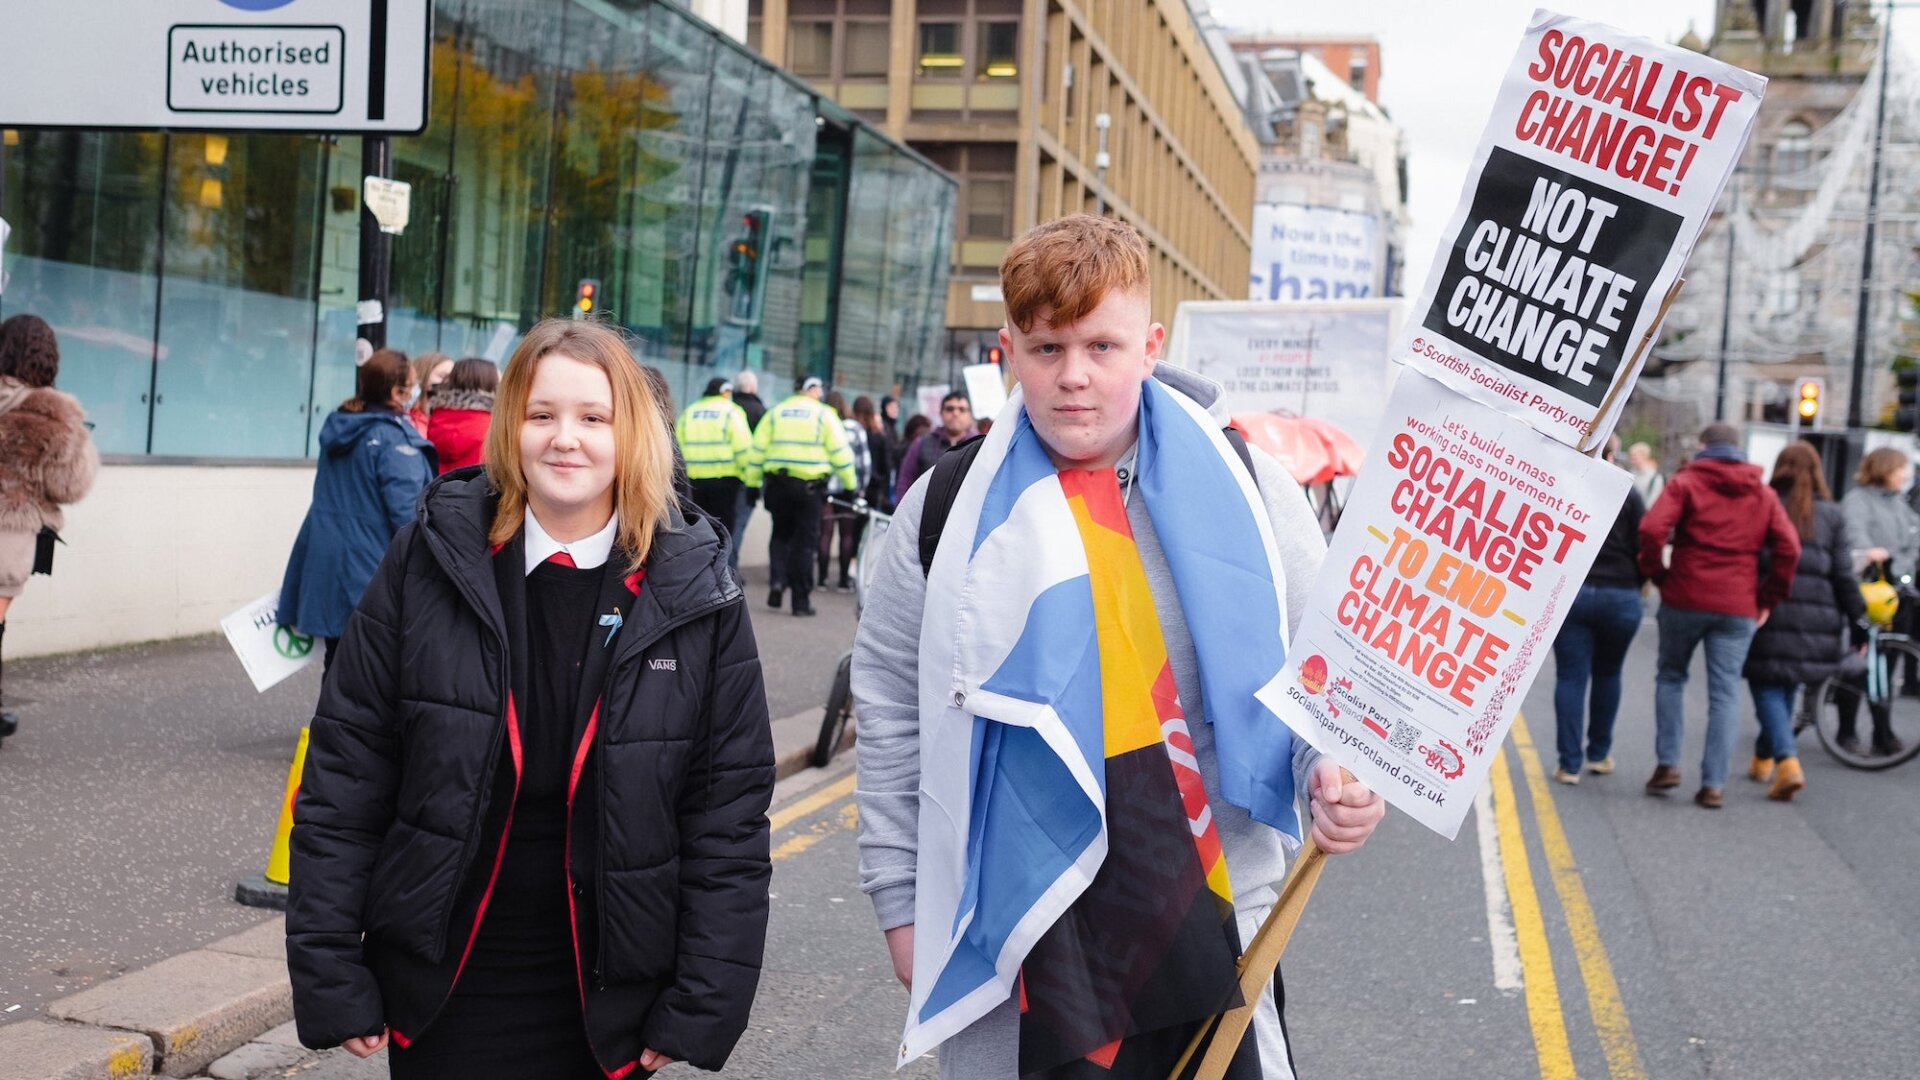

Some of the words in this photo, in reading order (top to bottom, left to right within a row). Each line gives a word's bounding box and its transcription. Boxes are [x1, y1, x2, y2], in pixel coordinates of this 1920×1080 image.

[182, 40, 330, 64] Authorised
[201, 72, 309, 96] vehicles
[1528, 29, 1742, 140] SOCIALIST
[1515, 90, 1699, 197] CHANGE!
[1270, 224, 1315, 242] Now
[1319, 229, 1331, 244] is
[1335, 232, 1362, 247] the
[1290, 249, 1329, 266] time
[1520, 176, 1619, 254] NOT
[1464, 219, 1637, 332] CLIMATE
[1446, 275, 1610, 387] CHANGE
[1423, 344, 1475, 377] Scottish
[1470, 367, 1529, 404] Socialist
[1529, 394, 1592, 437] Party.org
[1407, 416, 1451, 451] working
[1450, 443, 1484, 469] class
[1485, 462, 1563, 512] movement
[1565, 503, 1591, 524] for
[1442, 415, 1468, 441] Let's
[1469, 431, 1505, 460] build
[1504, 453, 1516, 466] a
[1516, 459, 1557, 488] mass
[1387, 433, 1586, 564] SOCIALIST
[1390, 480, 1544, 591] CHANGE
[1349, 555, 1509, 676] CLIMATE
[1384, 526, 1429, 579] TO
[1425, 552, 1506, 618] END
[648, 658, 677, 671] VANS
[1337, 591, 1486, 707] CHANGE
[1286, 686, 1446, 807] socialistpartyscotland.org.uk
[1328, 693, 1364, 722] Scotland
[1334, 681, 1366, 710] Socialist
[1368, 706, 1393, 729] Party
